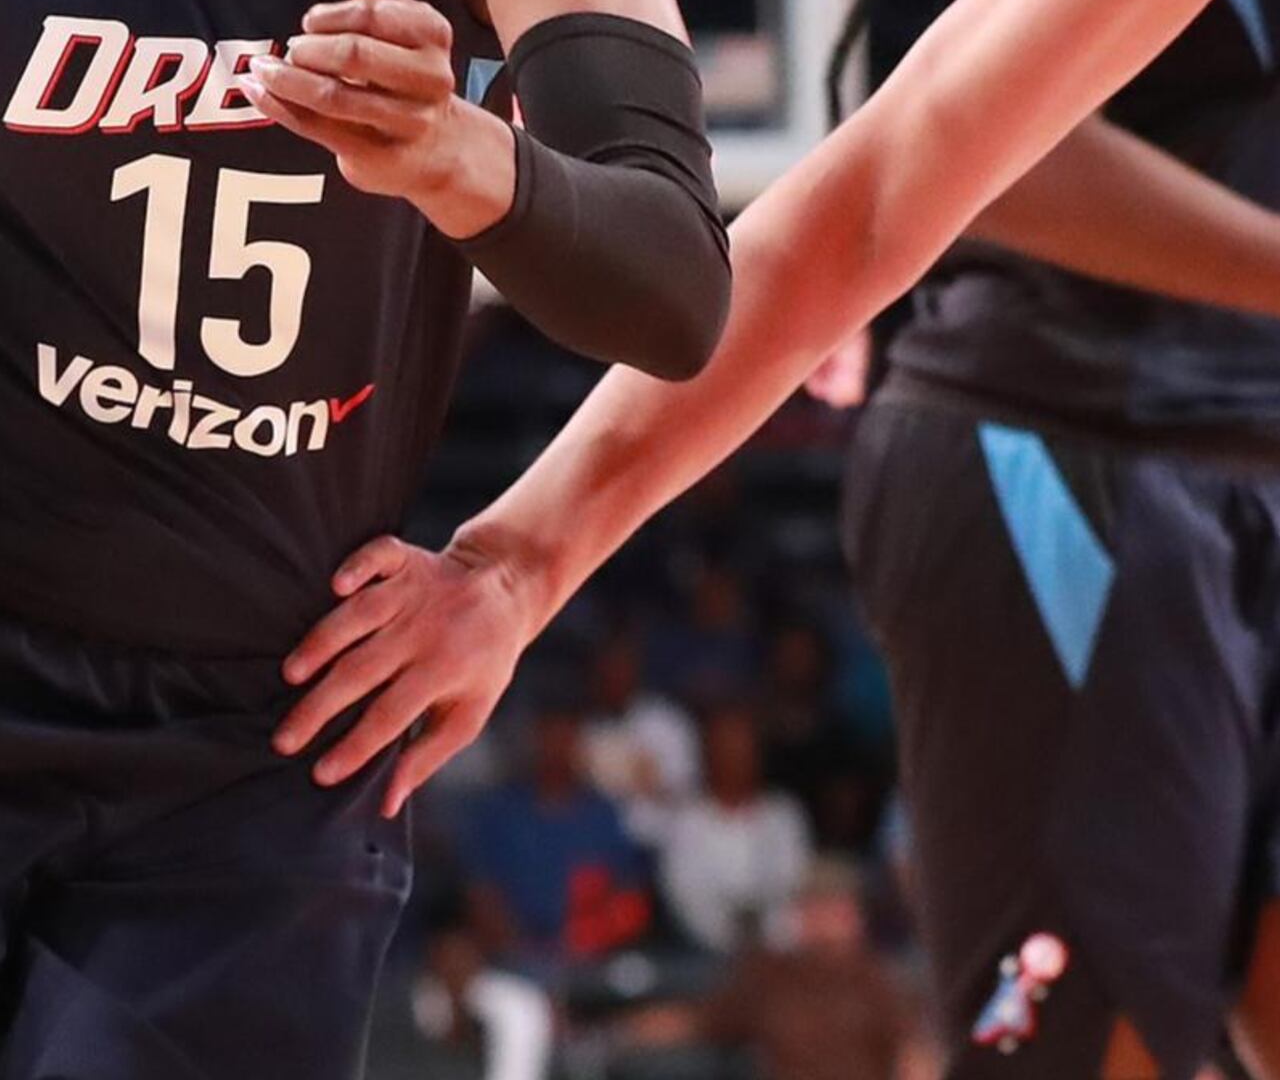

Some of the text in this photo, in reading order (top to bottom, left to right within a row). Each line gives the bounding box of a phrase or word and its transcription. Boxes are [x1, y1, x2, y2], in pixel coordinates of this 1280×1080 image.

[3, 15, 295, 134] DRE
[110, 153, 325, 377] 15
[37, 343, 331, 457] verizon
